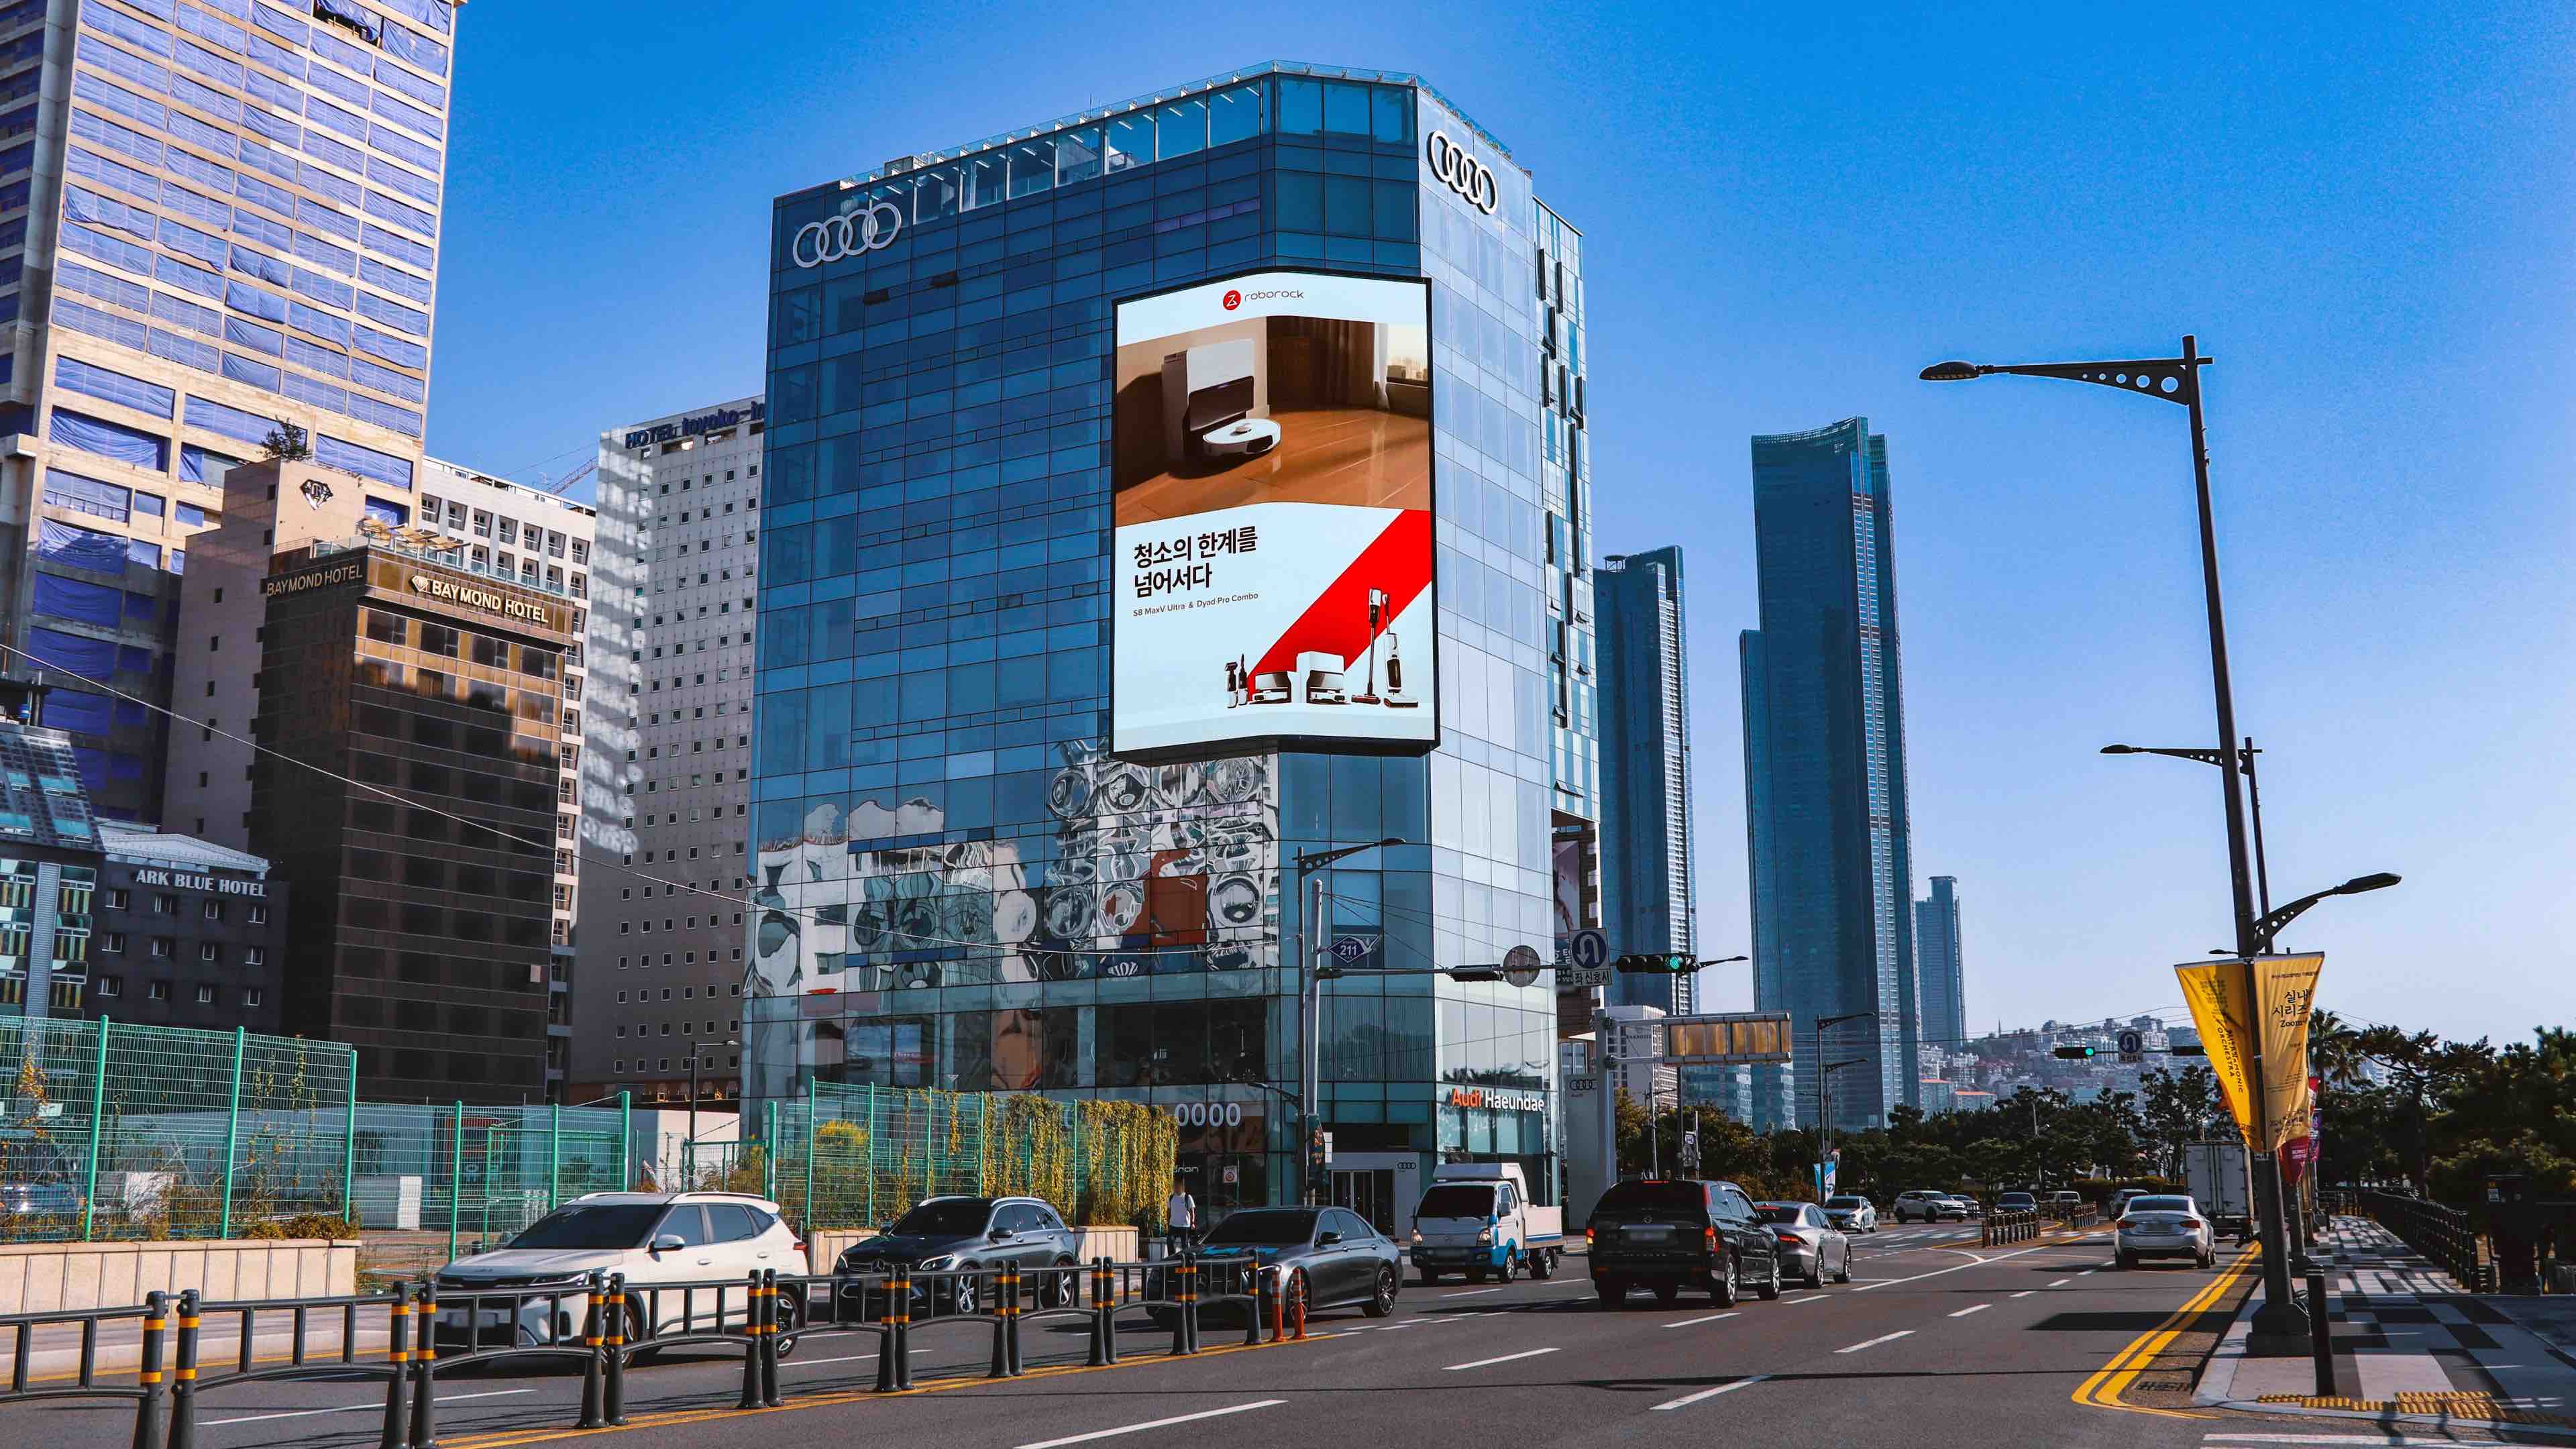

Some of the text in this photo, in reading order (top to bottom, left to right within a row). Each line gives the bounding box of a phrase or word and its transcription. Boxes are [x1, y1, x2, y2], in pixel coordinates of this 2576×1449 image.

[1244, 289, 1304, 301] roborock
[625, 423, 677, 449] HOTEL
[1134, 526, 1258, 568] 청소의 한계를
[267, 564, 363, 596] BAYMOND HOTEL
[1134, 562, 1213, 598] 넘어서다
[432, 580, 549, 623] BAYMOND HOTEL
[1133, 608, 1143, 616] S8
[1144, 605, 1166, 615] MaxV
[1167, 602, 1185, 612] Ultra
[1197, 598, 1216, 608] Dyad
[1218, 596, 1230, 604] Pro
[1232, 592, 1258, 602] Combo
[136, 869, 266, 897] ARK BLUE HOTEL
[1340, 945, 1357, 956] 211
[2218, 1027, 2235, 1077] ORCHESTRA
[1451, 1087, 1545, 1112] Audi Haeundae
